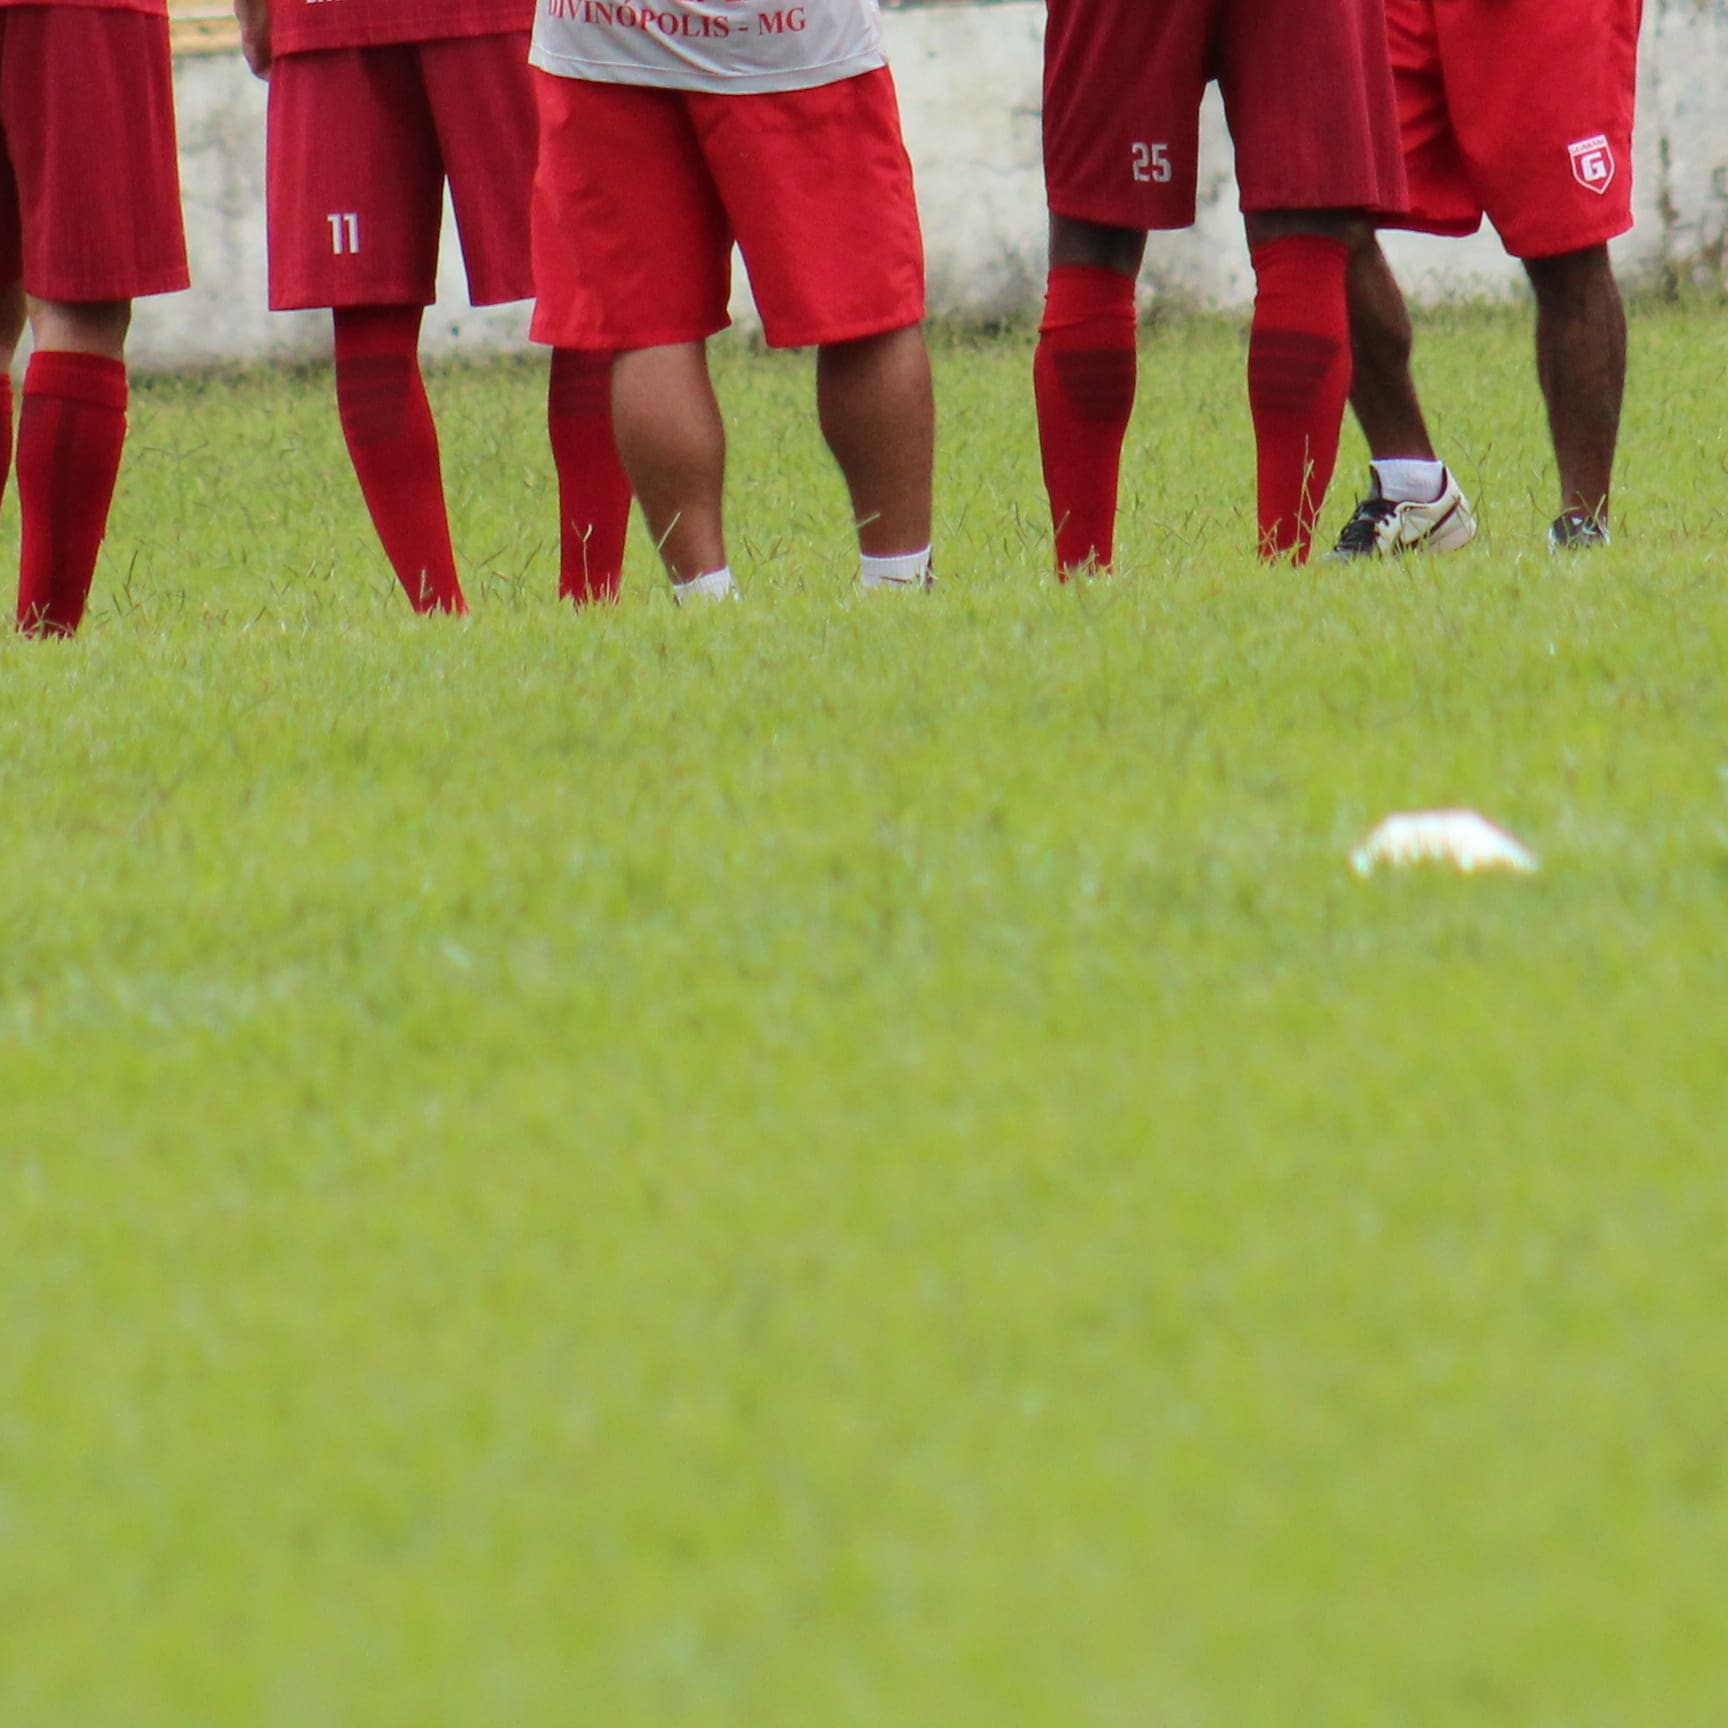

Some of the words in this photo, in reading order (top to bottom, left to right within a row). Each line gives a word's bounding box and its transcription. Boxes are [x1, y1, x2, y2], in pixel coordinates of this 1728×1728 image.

[758, 6, 807, 36] MG
[1132, 142, 1172, 182] 25
[1581, 151, 1607, 181] G
[327, 212, 360, 254] 11
